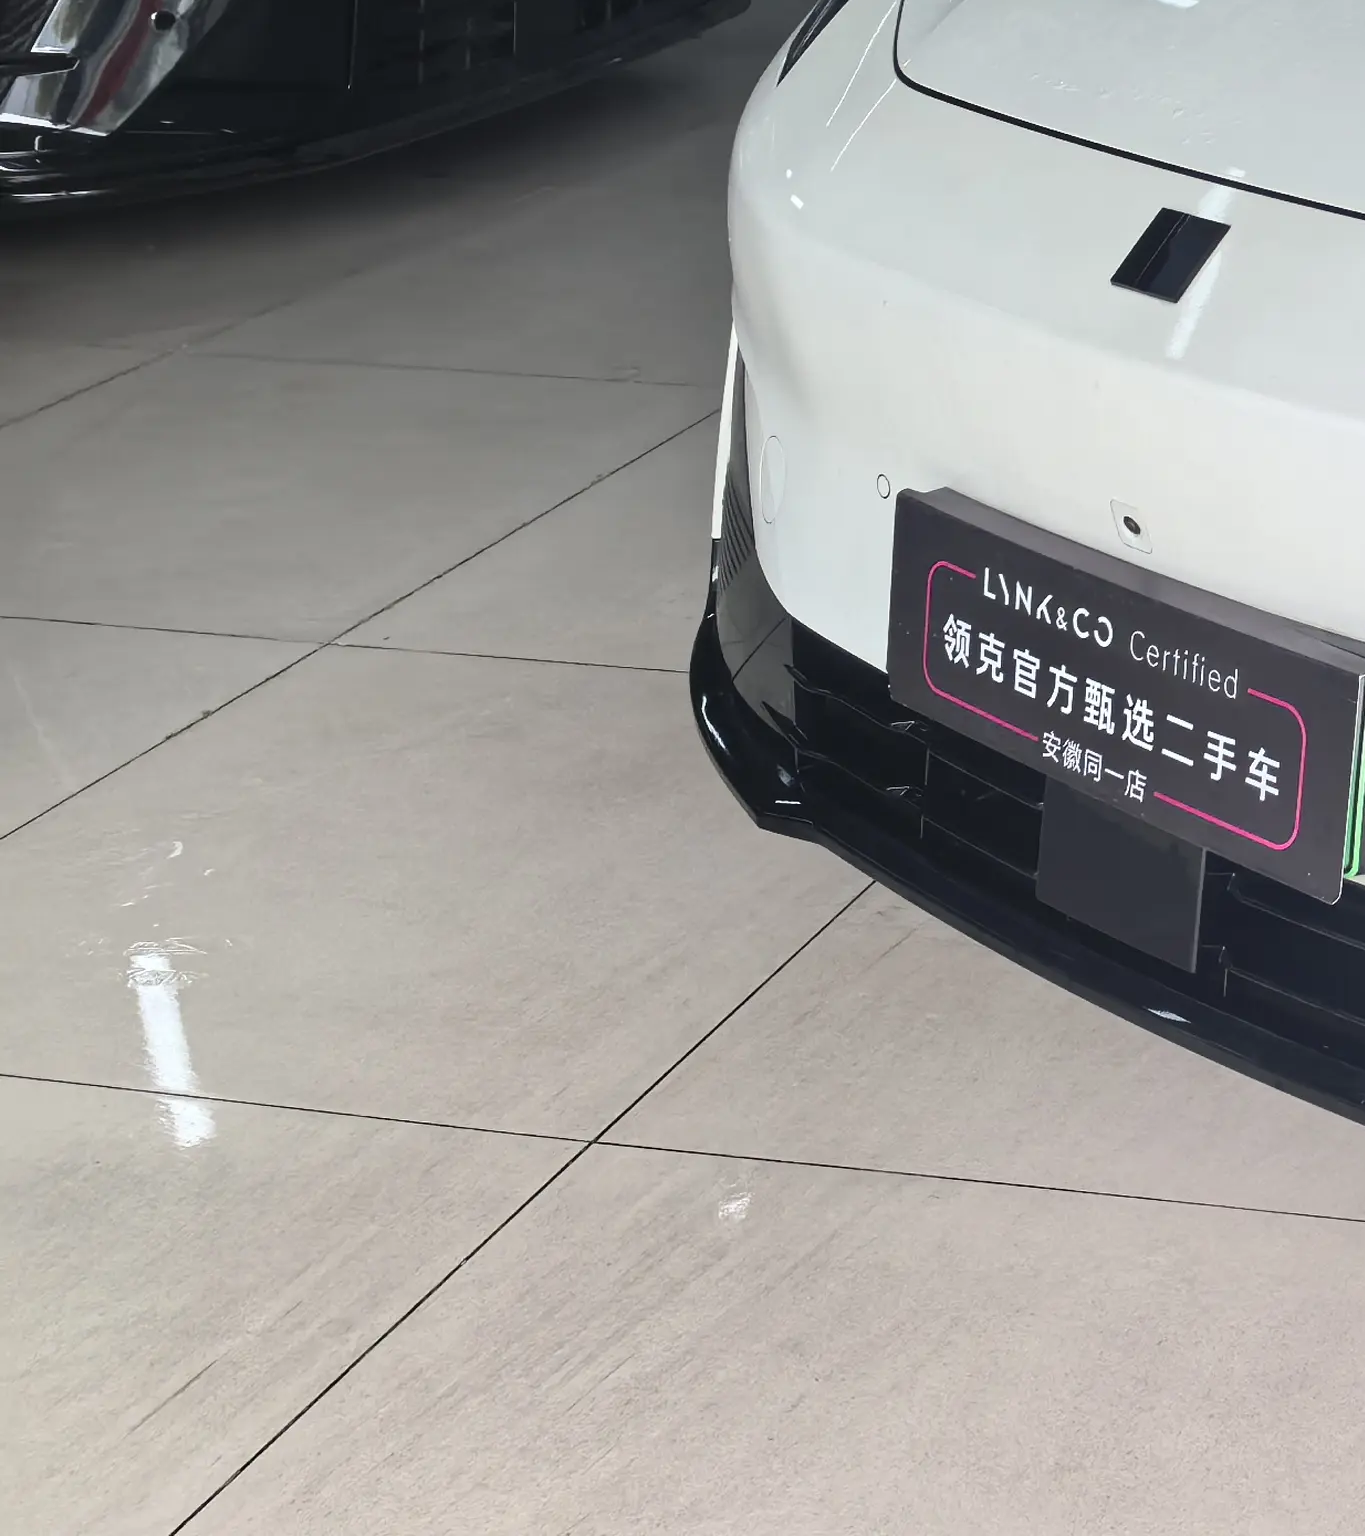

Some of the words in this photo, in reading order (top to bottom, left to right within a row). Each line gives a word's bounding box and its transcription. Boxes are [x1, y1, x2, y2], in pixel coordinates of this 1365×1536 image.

[983, 567, 1114, 648] LYNK&CO
[1129, 630, 1239, 700] Certified
[942, 613, 1281, 802] 领克官方甄选二手车
[1042, 730, 1148, 803] 安徽同一店
